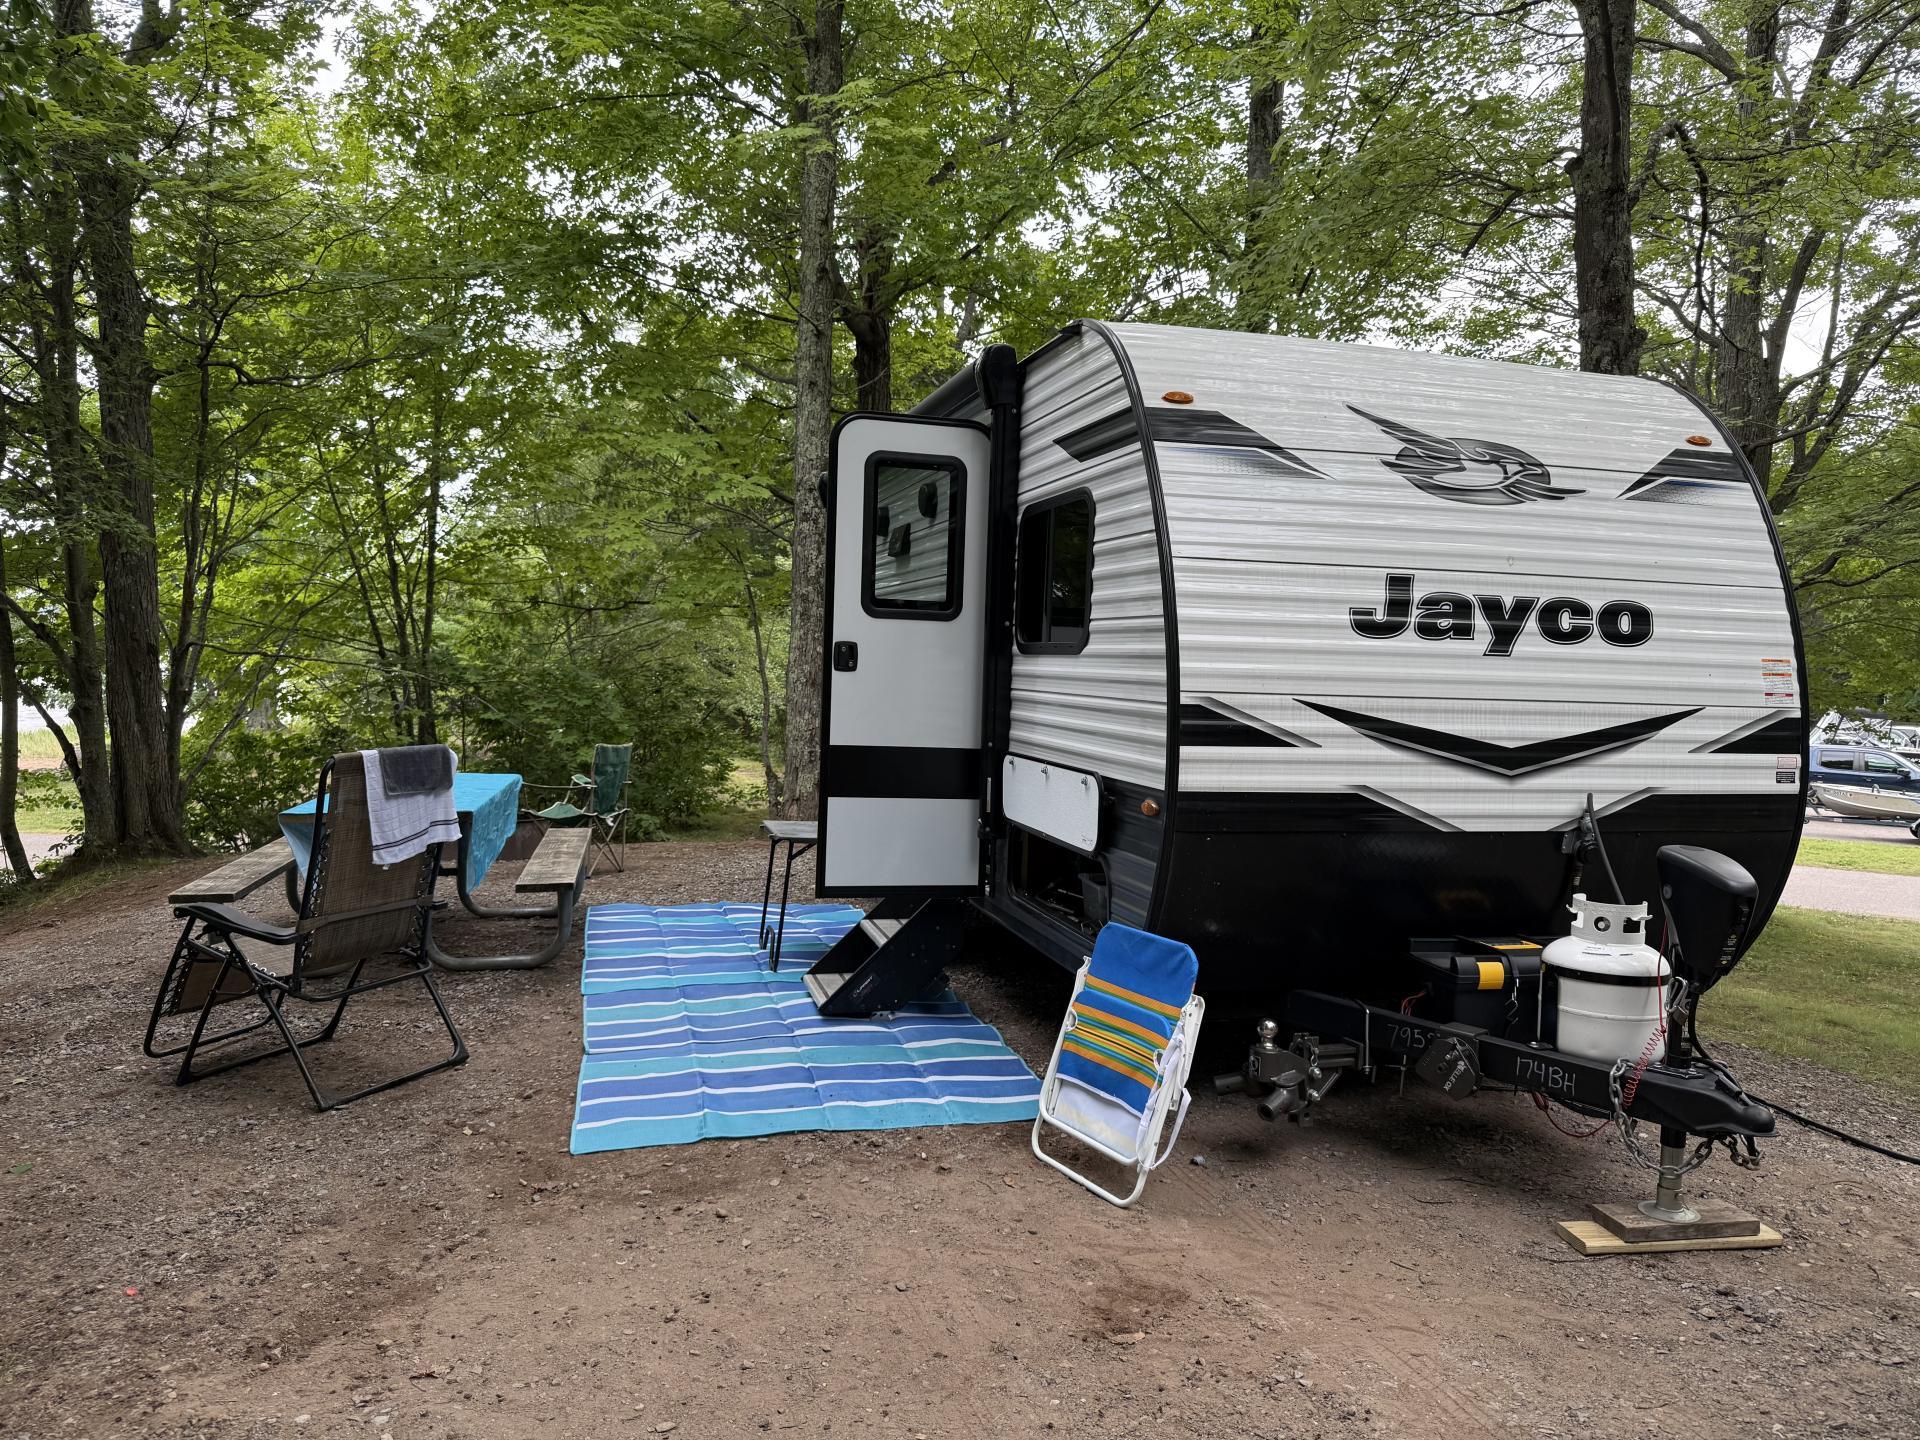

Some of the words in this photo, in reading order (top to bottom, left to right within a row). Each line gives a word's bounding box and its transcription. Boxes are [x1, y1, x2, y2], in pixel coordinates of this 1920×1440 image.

[1349, 573, 1654, 657] Jayco
[1386, 1024, 1441, 1048] 795
[1517, 1056, 1576, 1096] 174BH
